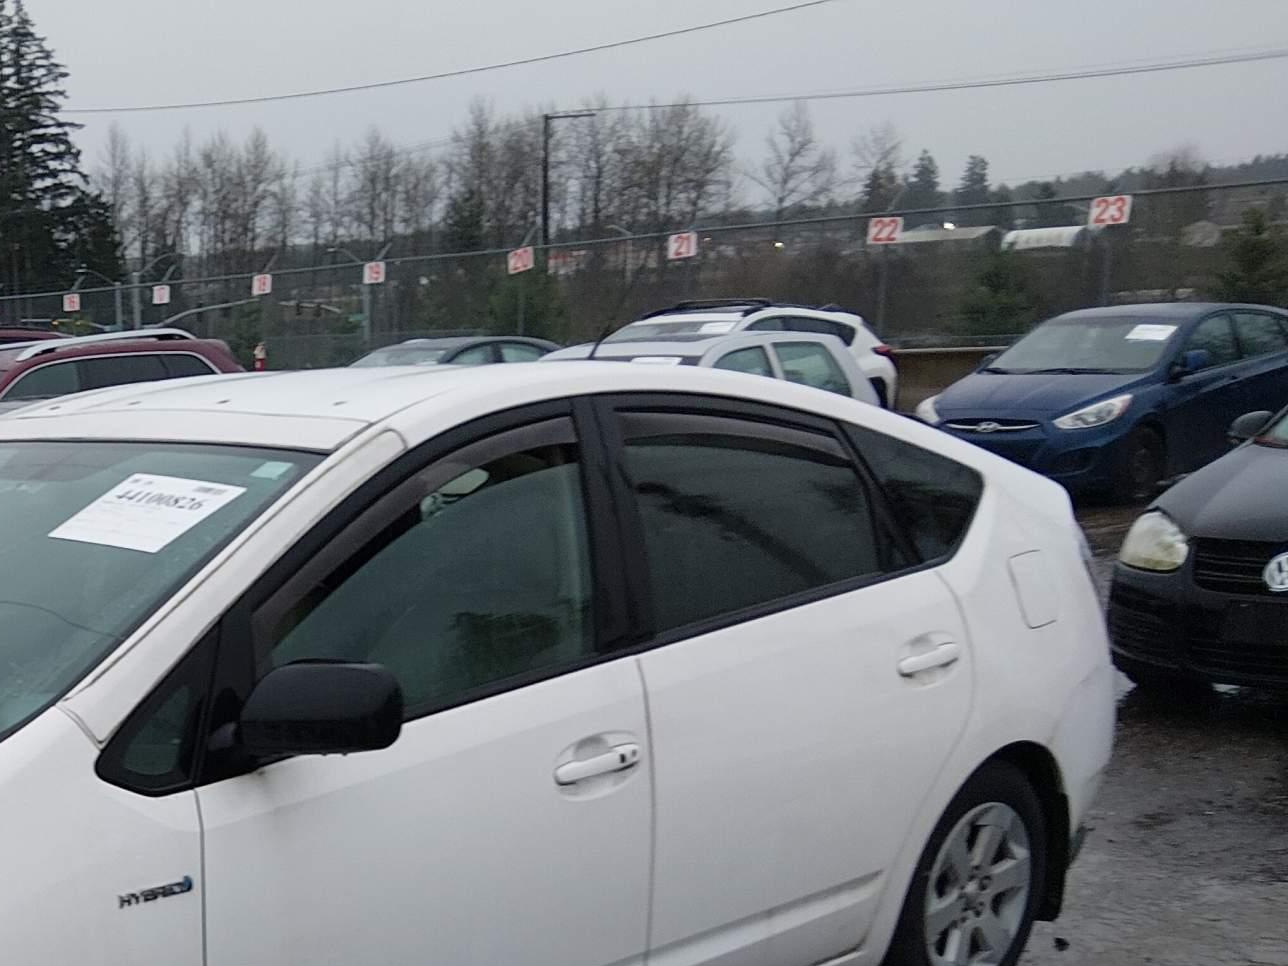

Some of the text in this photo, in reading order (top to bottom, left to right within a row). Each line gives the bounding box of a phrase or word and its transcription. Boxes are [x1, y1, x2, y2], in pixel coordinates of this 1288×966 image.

[1094, 197, 1127, 223] 23
[871, 218, 899, 242] 22
[673, 234, 692, 257] 21
